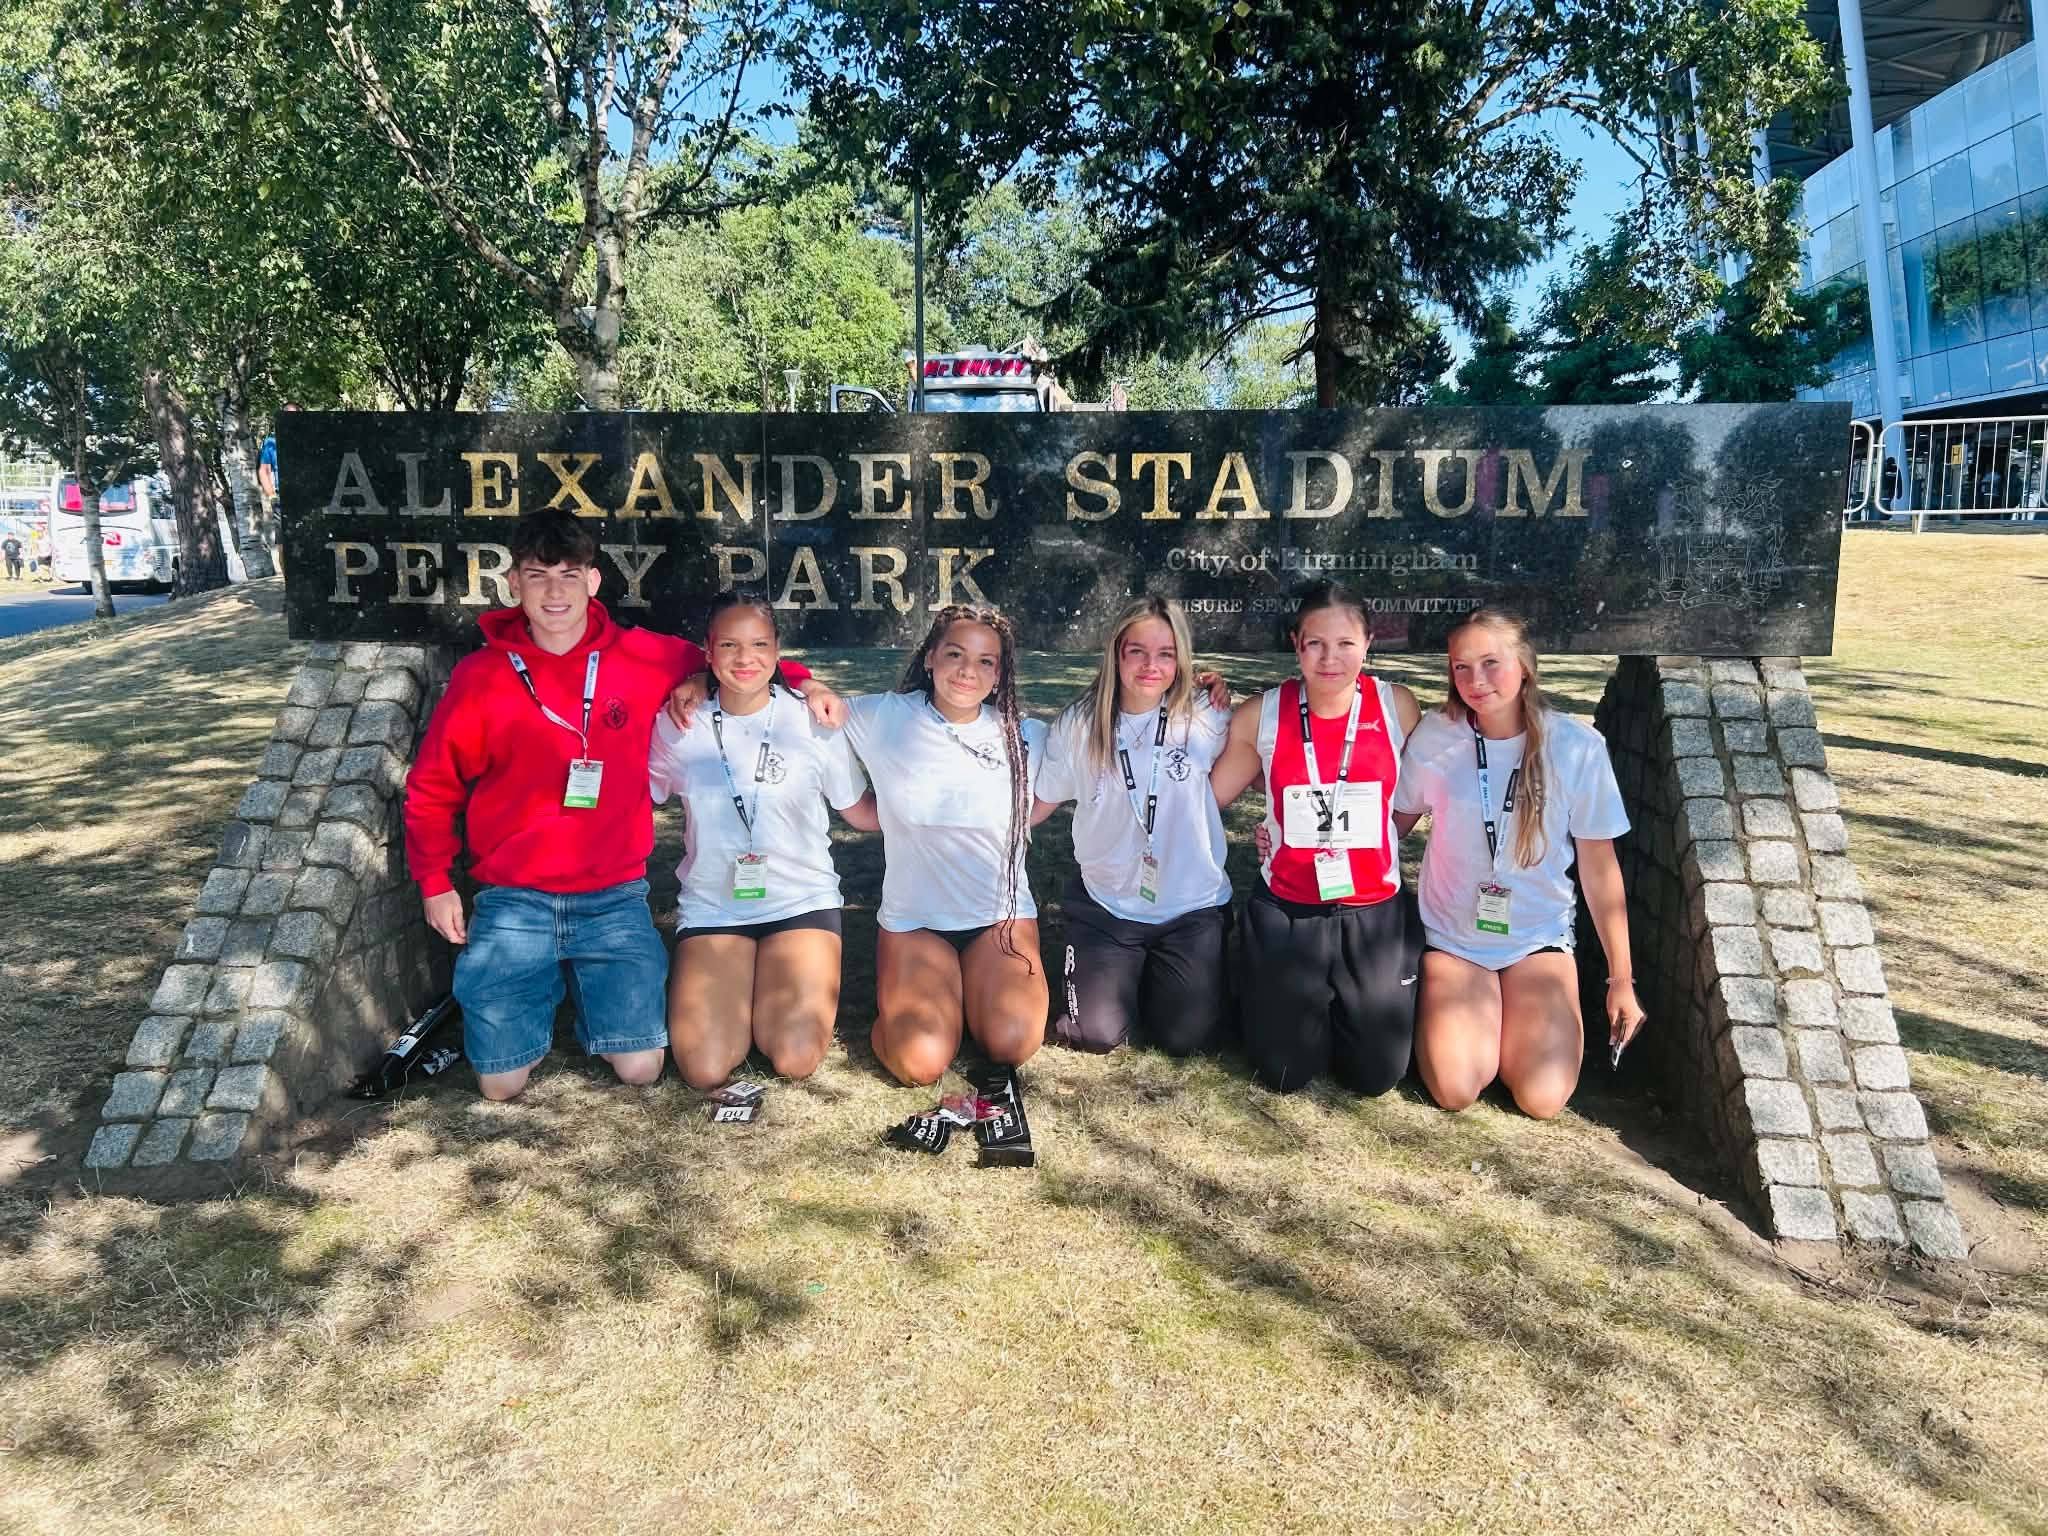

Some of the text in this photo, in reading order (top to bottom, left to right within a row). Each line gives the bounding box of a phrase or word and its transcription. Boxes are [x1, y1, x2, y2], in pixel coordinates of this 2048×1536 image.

[321, 449, 1594, 521] ALEXANDER STADIUM
[325, 541, 994, 613] PERY PARK
[1166, 547, 1478, 577] City of Birmingham
